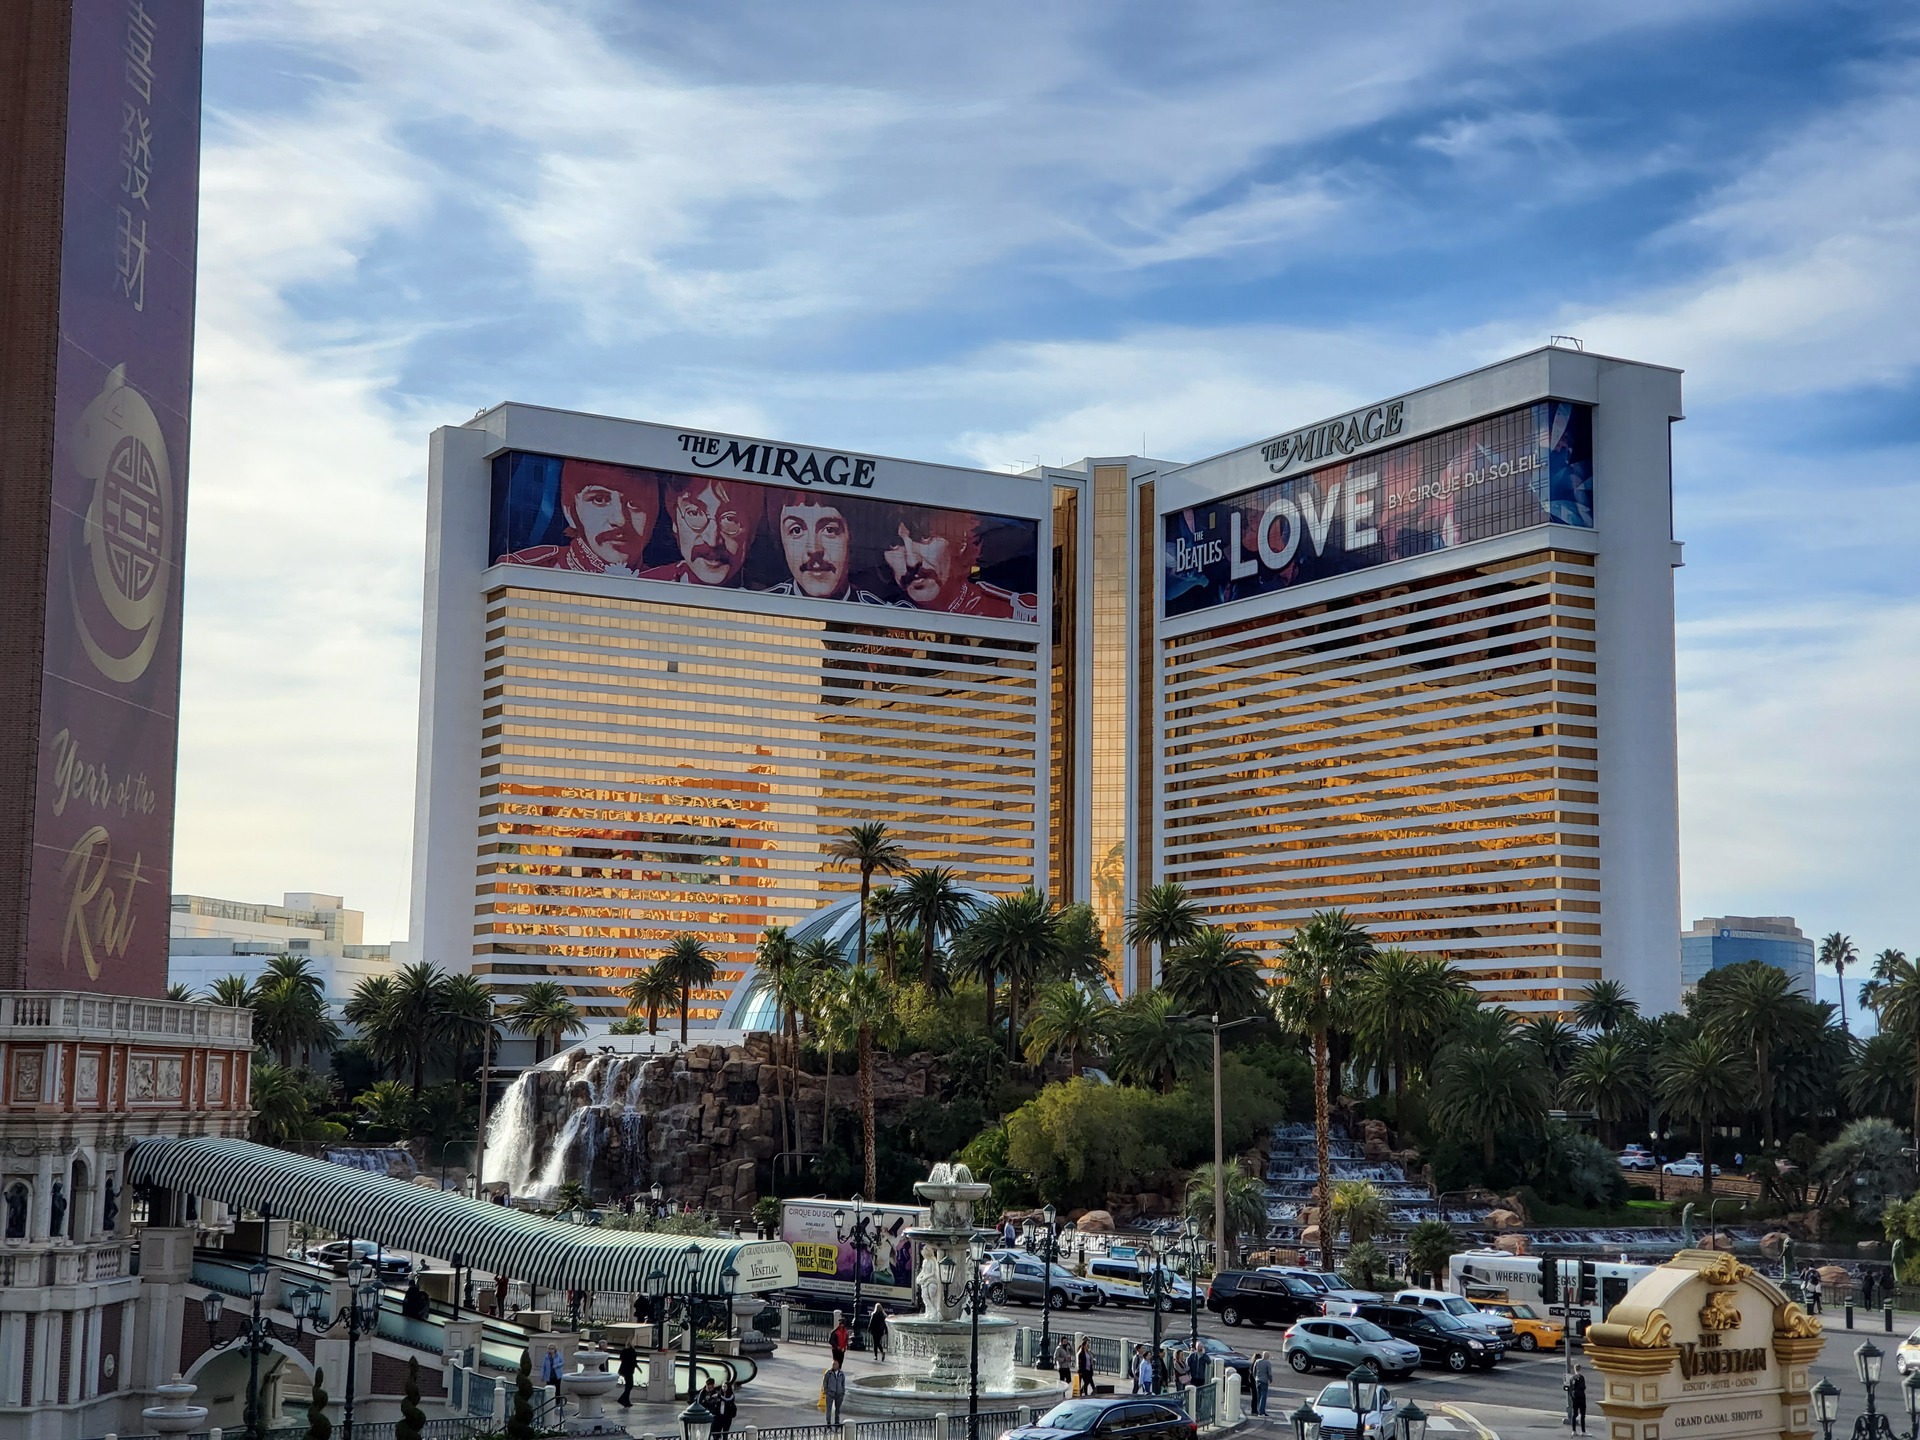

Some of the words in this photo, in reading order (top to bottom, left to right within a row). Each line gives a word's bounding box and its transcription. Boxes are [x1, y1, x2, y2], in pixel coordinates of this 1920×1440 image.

[678, 434, 720, 455] THE
[1269, 401, 1404, 474] MIRAGE
[1261, 438, 1289, 462] THE
[691, 441, 876, 488] MIRAGE
[1388, 491, 1406, 509] BY
[1408, 475, 1461, 499] CIRQUE
[1465, 468, 1485, 487] DU
[1194, 531, 1204, 541] THE
[1231, 471, 1378, 581] LOVE
[1176, 537, 1223, 573] BEATLES
[50, 728, 112, 817] Year
[117, 773, 131, 818] of
[134, 771, 156, 815] the
[61, 825, 152, 981] Rat
[788, 1208, 811, 1218] CIRQUE
[796, 1246, 813, 1257] HALF
[751, 1264, 779, 1277] VENETIAN
[1495, 1271, 1523, 1282] WHERE
[1526, 1273, 1539, 1284] YO
[1698, 1334, 1722, 1347] THE
[1674, 1342, 1767, 1381] VENETIAN
[1682, 1382, 1707, 1392] RESORT
[1711, 1380, 1731, 1390] HOTEL
[1735, 1378, 1758, 1387] CASINO
[1675, 1415, 1702, 1427] GRAND
[1704, 1413, 1730, 1424] CANAL
[1732, 1410, 1763, 1421] SHOPPES
